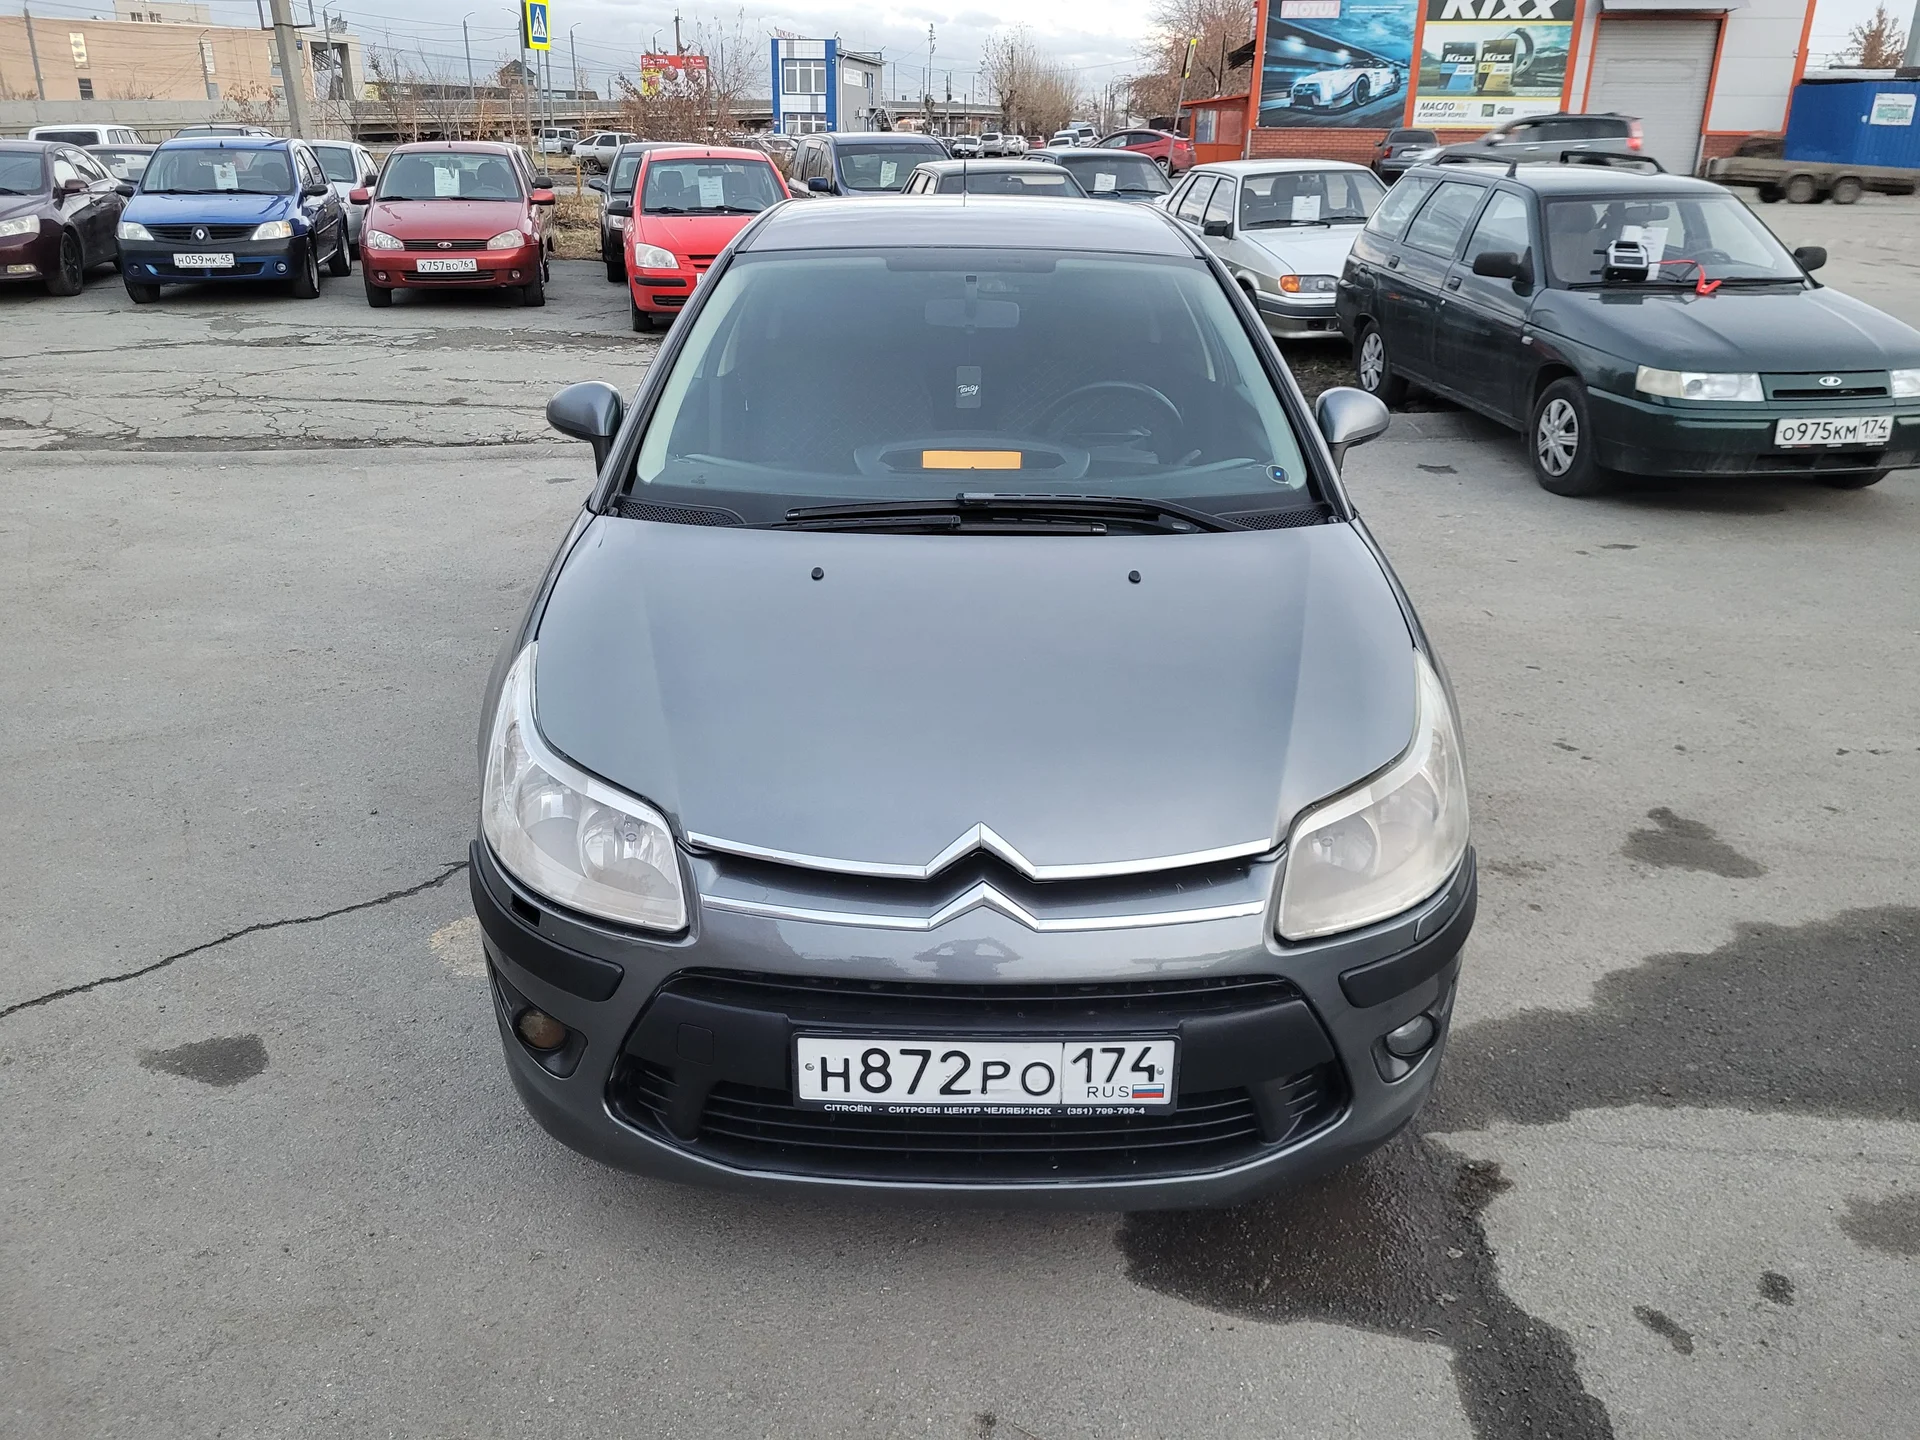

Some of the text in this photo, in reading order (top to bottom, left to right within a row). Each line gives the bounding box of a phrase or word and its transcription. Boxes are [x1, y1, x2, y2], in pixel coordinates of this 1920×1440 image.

[1284, 2, 1337, 16] MOTUL
[1444, 53, 1475, 63] Kixx
[1482, 52, 1512, 62] Kixx
[1419, 102, 1455, 111] МАСЛО
[178, 254, 231, 265] Н059МК 45
[420, 260, 474, 271] Х757ВО 761
[1783, 419, 1887, 441] О975КМ 174
[820, 1046, 1156, 1096] Н872РО 174
[1087, 1085, 1129, 1098] RUS
[824, 1104, 872, 1113] CITROËN
[888, 1106, 941, 1114] СИТРОЕН
[944, 1106, 981, 1115] ЦЕНТР
[1067, 1106, 1093, 1116] (351)
